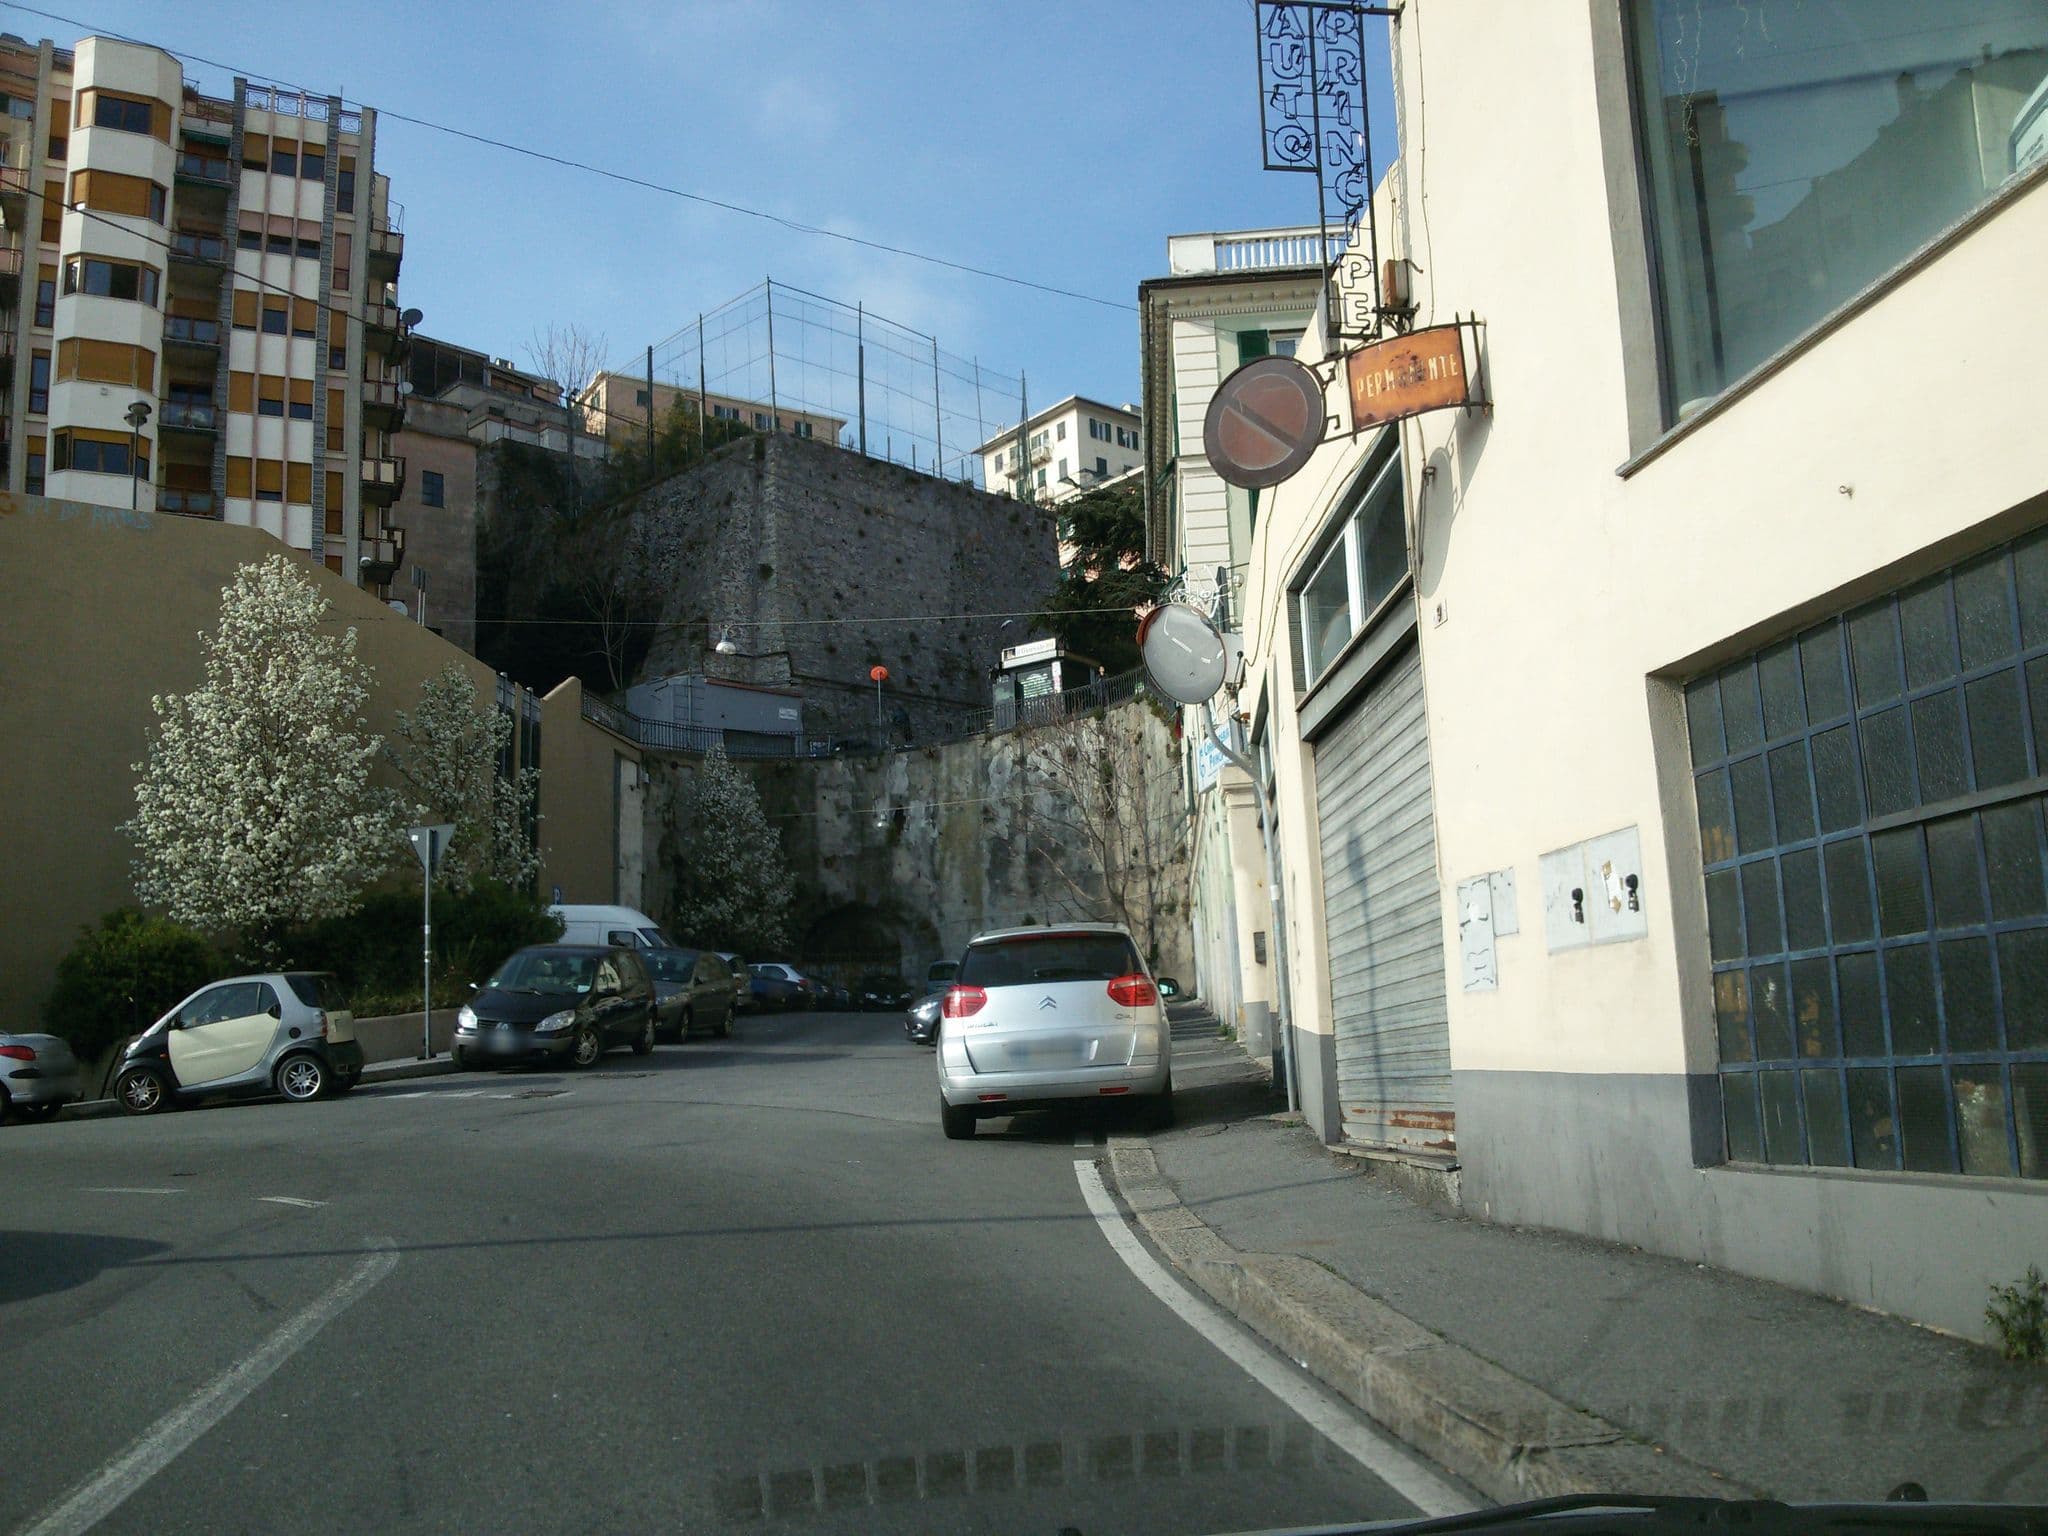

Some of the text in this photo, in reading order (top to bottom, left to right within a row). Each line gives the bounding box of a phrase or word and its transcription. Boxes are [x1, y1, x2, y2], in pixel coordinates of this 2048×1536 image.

[1266, 4, 1312, 163] AUTO
[1324, 8, 1372, 329] PRINCIPE
[1356, 353, 1459, 401] PERMNTE
